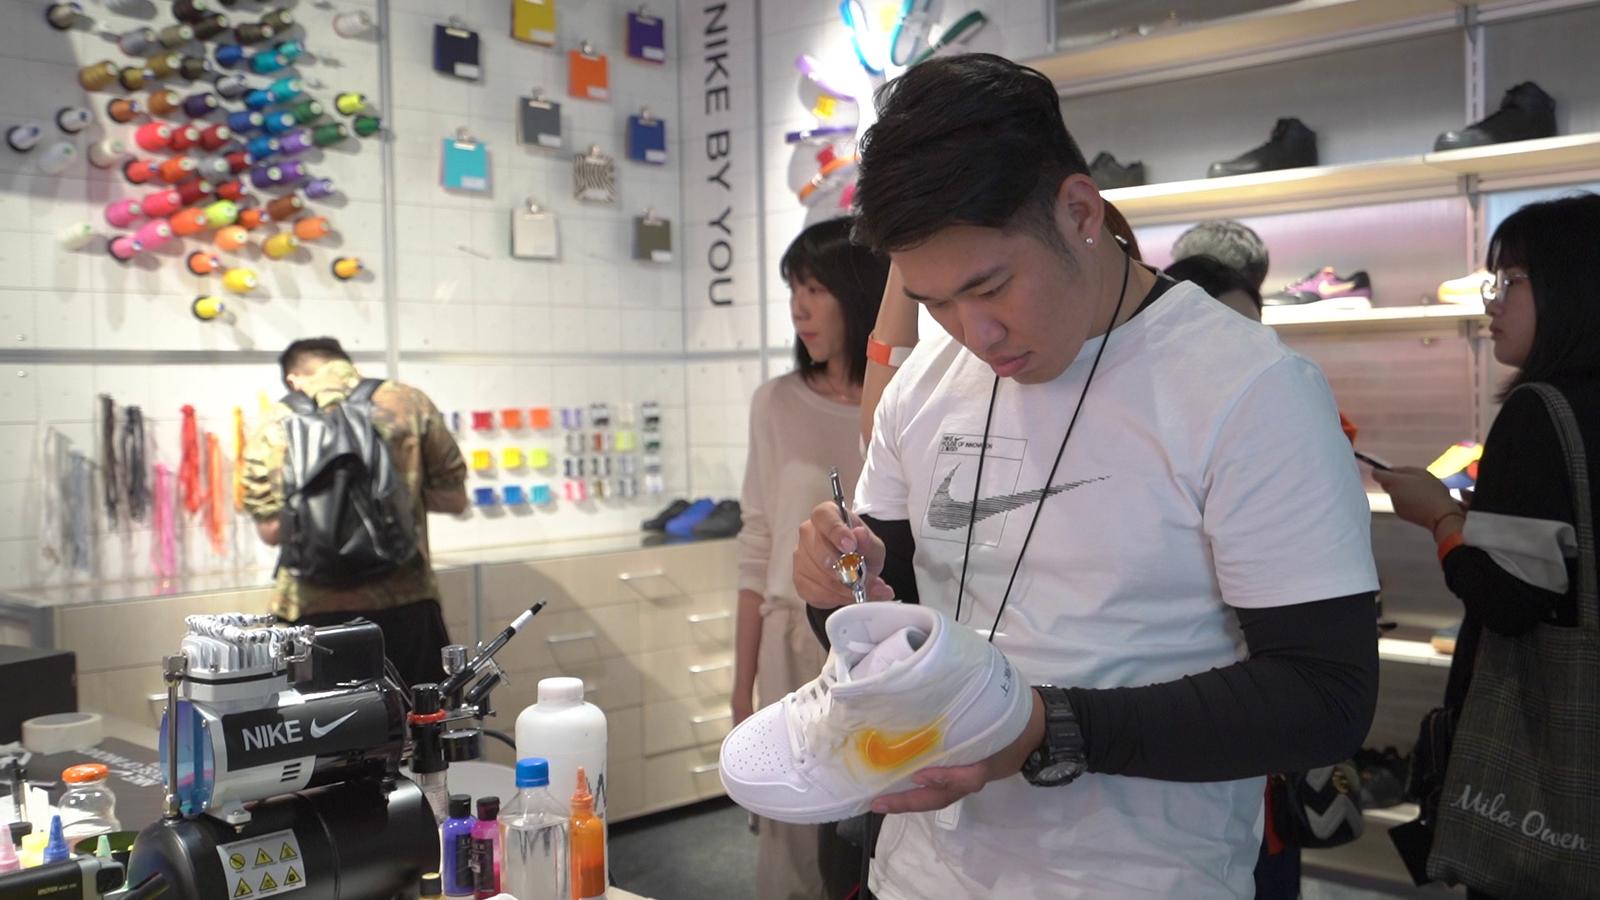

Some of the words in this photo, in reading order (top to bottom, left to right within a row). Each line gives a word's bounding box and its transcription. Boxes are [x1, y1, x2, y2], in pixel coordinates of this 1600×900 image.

[704, 3, 729, 115] NIKE
[706, 130, 731, 190] BY
[708, 205, 732, 306] YOU
[241, 720, 303, 751] NIKE
[1450, 785, 1516, 827] Mila
[1521, 810, 1591, 851] Owen
